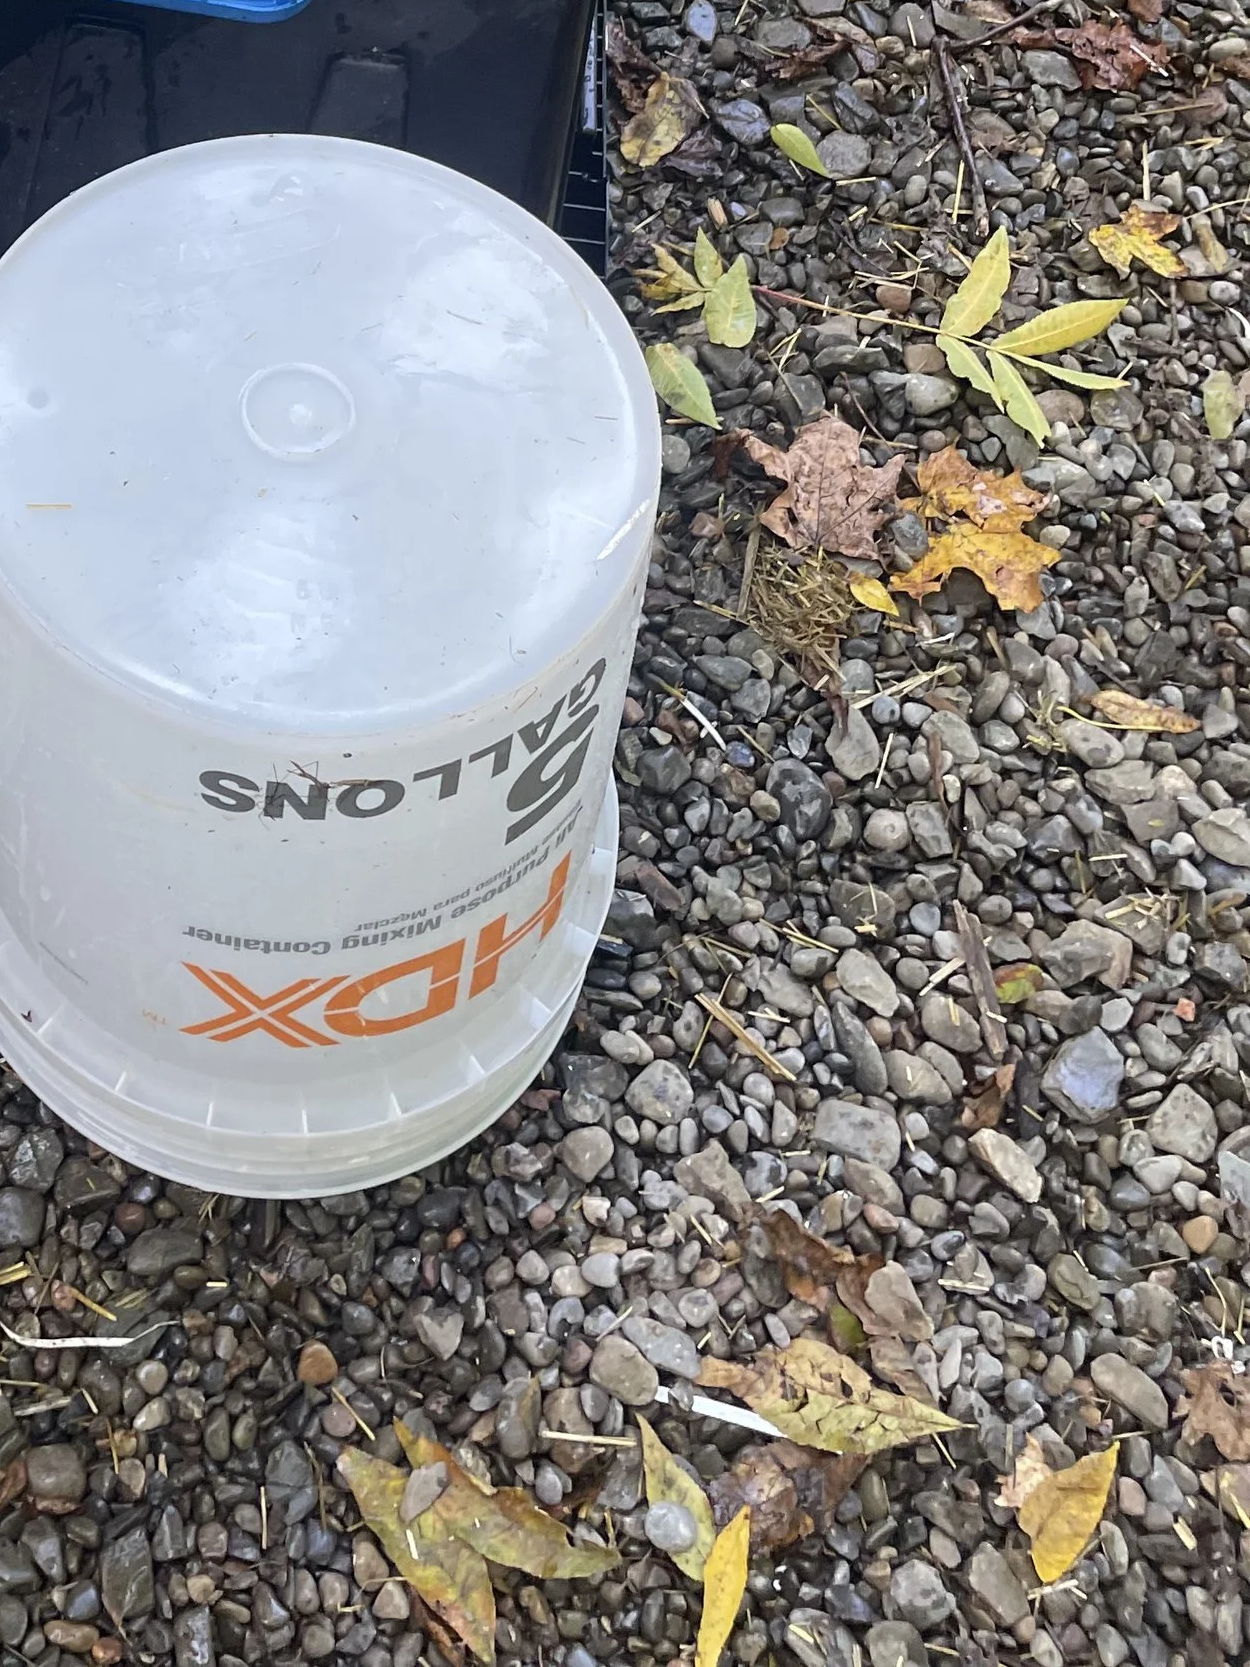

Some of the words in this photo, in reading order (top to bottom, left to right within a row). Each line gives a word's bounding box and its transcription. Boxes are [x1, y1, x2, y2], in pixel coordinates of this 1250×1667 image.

[197, 656, 608, 822] GALLONS
[504, 703, 600, 847] 5
[554, 804, 583, 848] All
[433, 888, 471, 912] para
[450, 851, 550, 921] Purpose
[178, 850, 572, 1050] HDX
[181, 924, 332, 956] Container
[340, 915, 442, 953] Mixing
